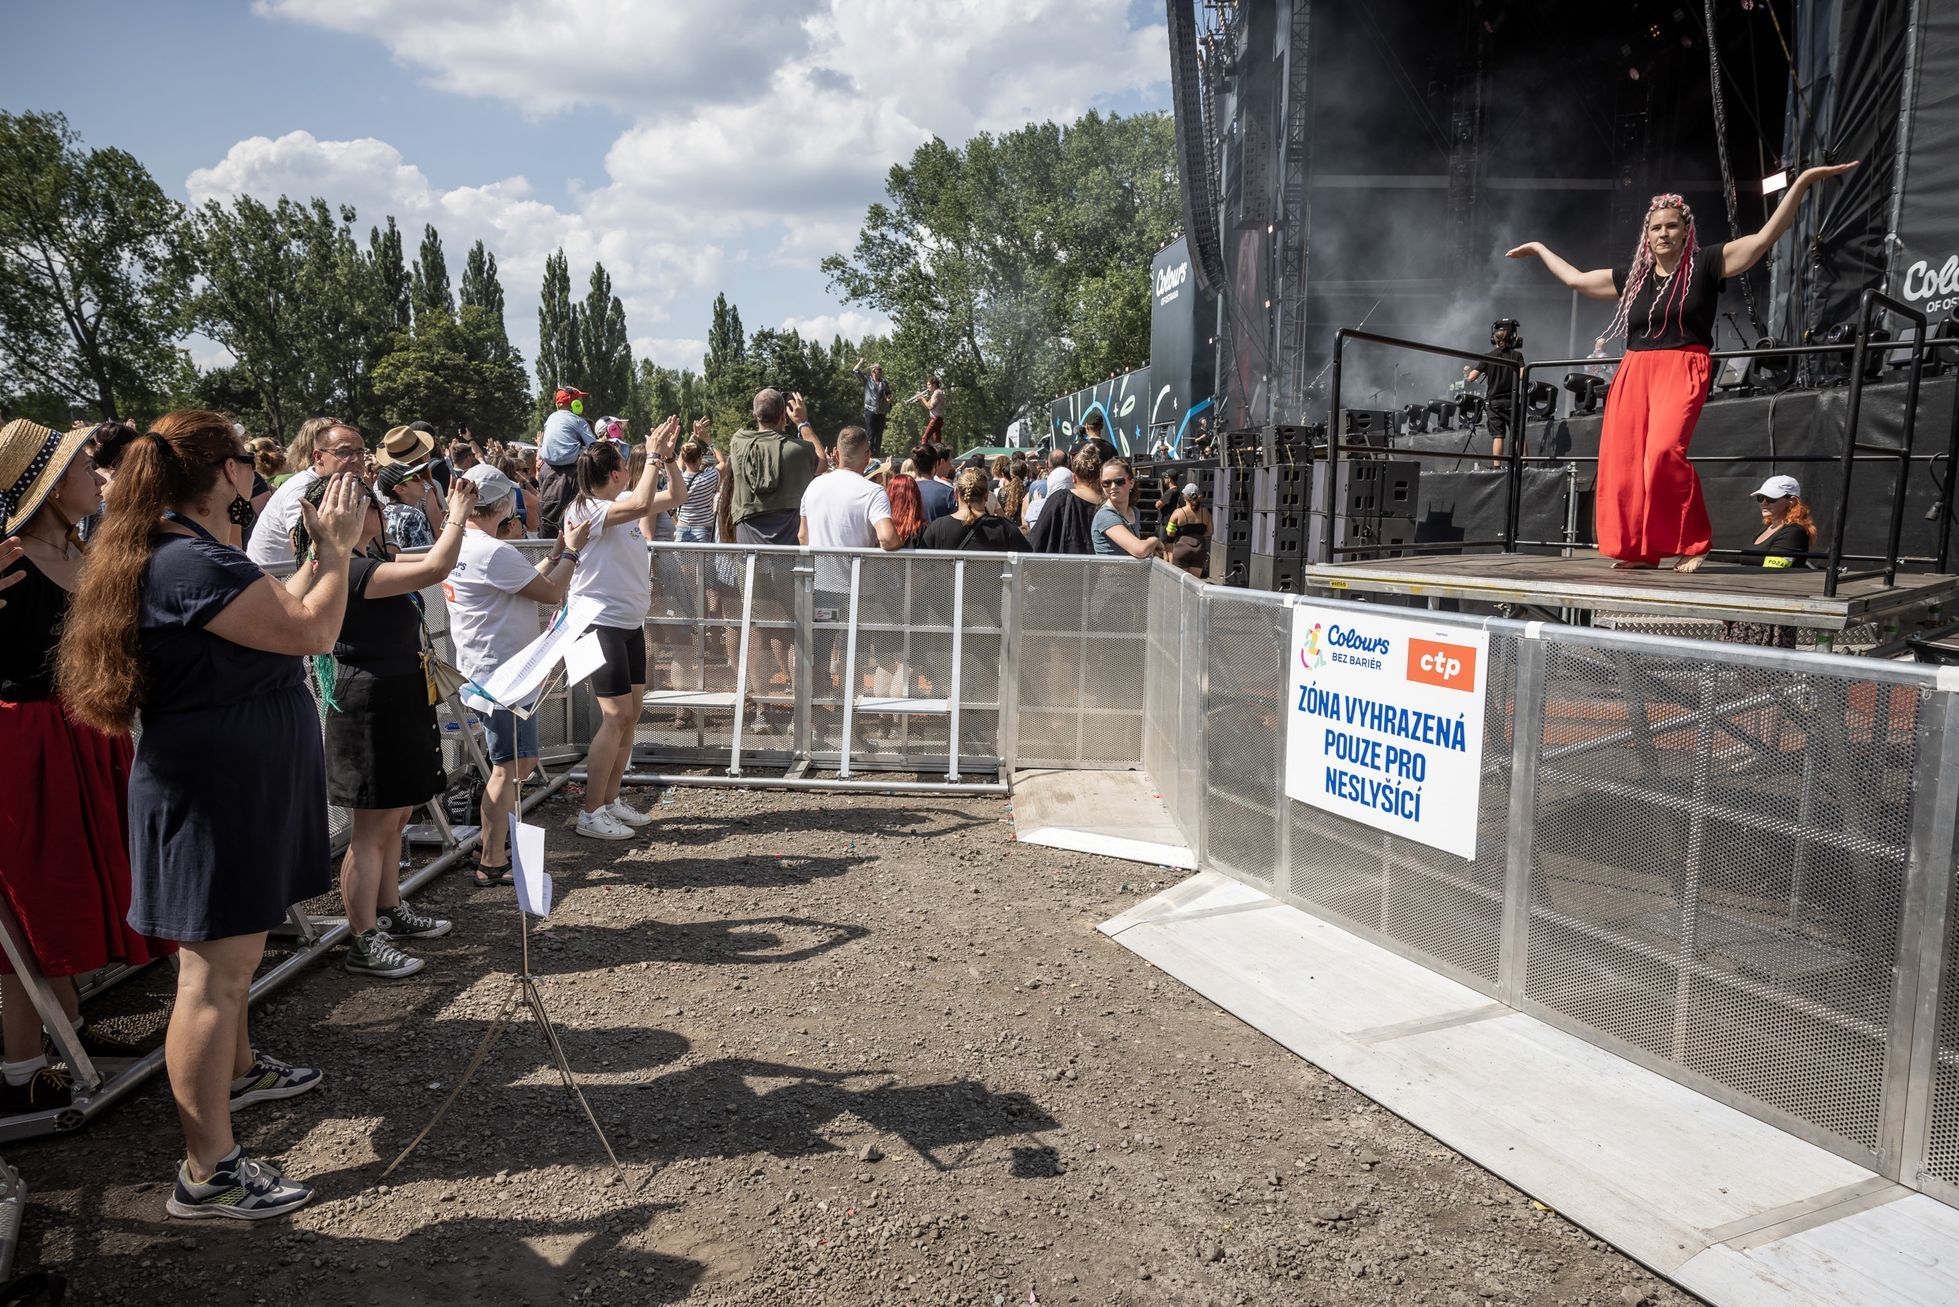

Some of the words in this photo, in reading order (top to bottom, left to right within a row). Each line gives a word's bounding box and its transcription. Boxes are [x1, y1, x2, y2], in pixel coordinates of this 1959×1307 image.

[1156, 262, 1187, 297] Colours
[1926, 300, 1941, 312] OF
[1943, 296, 1959, 310] OS
[1328, 624, 1390, 655] Colours
[1331, 652, 1348, 665] BEZ
[1349, 656, 1382, 671] BARIÉR
[1420, 651, 1461, 680] ctp
[1298, 680, 1341, 721] ZÓNA
[1345, 695, 1466, 752] VYHRAZENÁ
[1324, 728, 1382, 771] POUZE
[1385, 746, 1426, 783] PRO
[1325, 766, 1423, 822] NESLYŠÍCÍ
